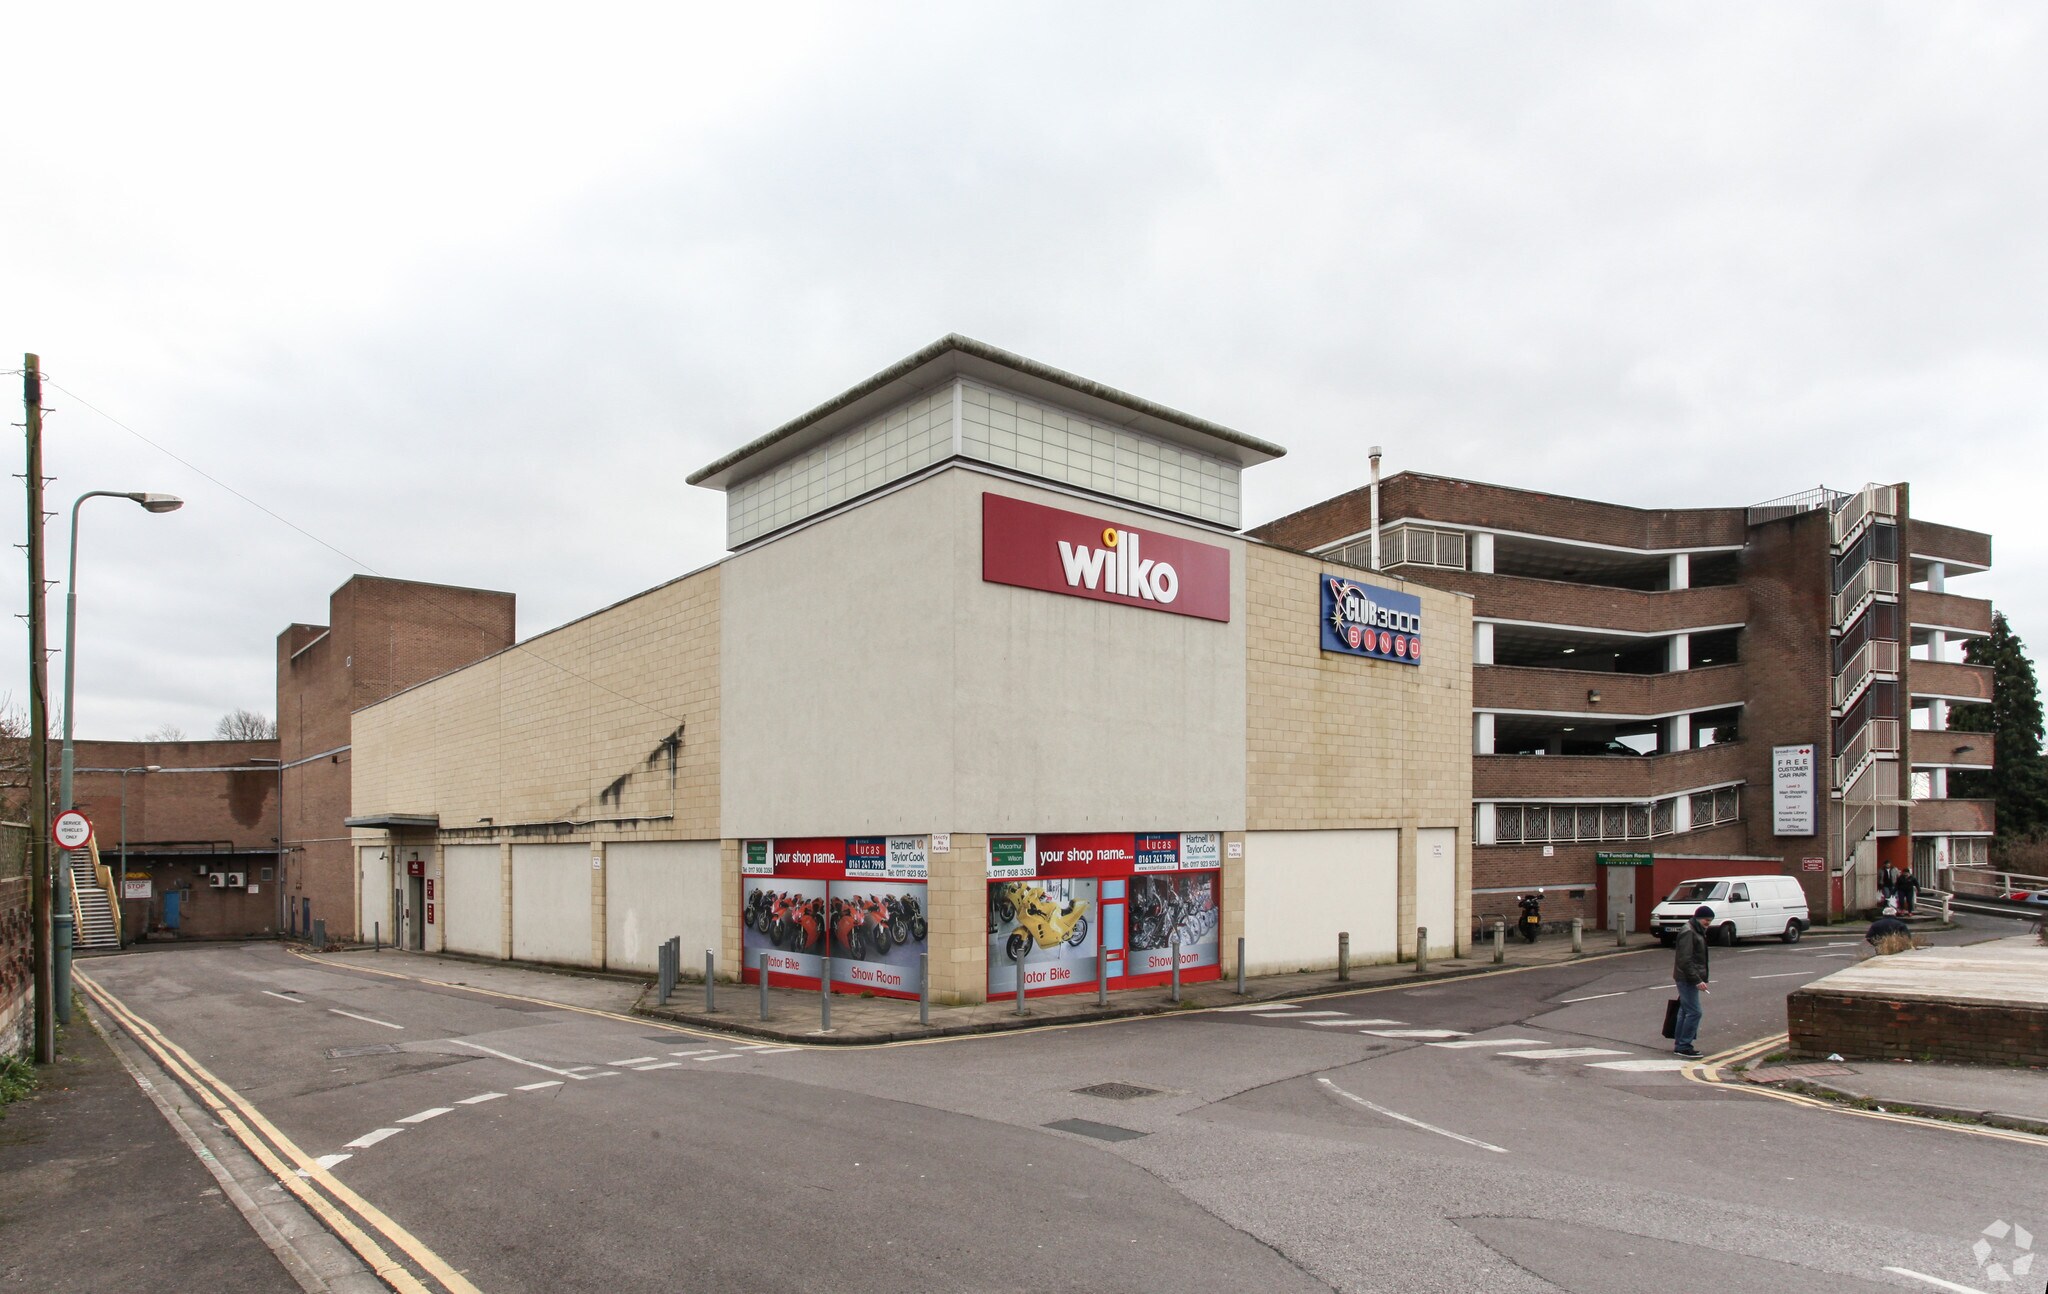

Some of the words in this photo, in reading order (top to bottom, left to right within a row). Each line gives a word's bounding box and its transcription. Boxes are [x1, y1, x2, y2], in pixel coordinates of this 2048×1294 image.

[1058, 528, 1179, 604] wilko
[1350, 630, 1420, 655] BINGO
[1778, 758, 1808, 766] FREE
[1186, 834, 1208, 843] Hartnell
[891, 840, 915, 850] Hartnell
[774, 853, 790, 866] your
[792, 850, 811, 866] shop
[1040, 850, 1064, 866] your
[1067, 848, 1093, 864] shop
[1138, 855, 1152, 863] 0161
[1153, 855, 1163, 863] 241
[849, 860, 860, 868] 0161
[861, 860, 871, 869] 241
[994, 869, 1005, 877] 0117
[1020, 868, 1034, 876] 3350
[786, 957, 799, 971] Bike
[1148, 957, 1173, 968] Show
[852, 967, 874, 981] Show
[877, 970, 901, 986] Room
[1050, 968, 1070, 980] Bike
